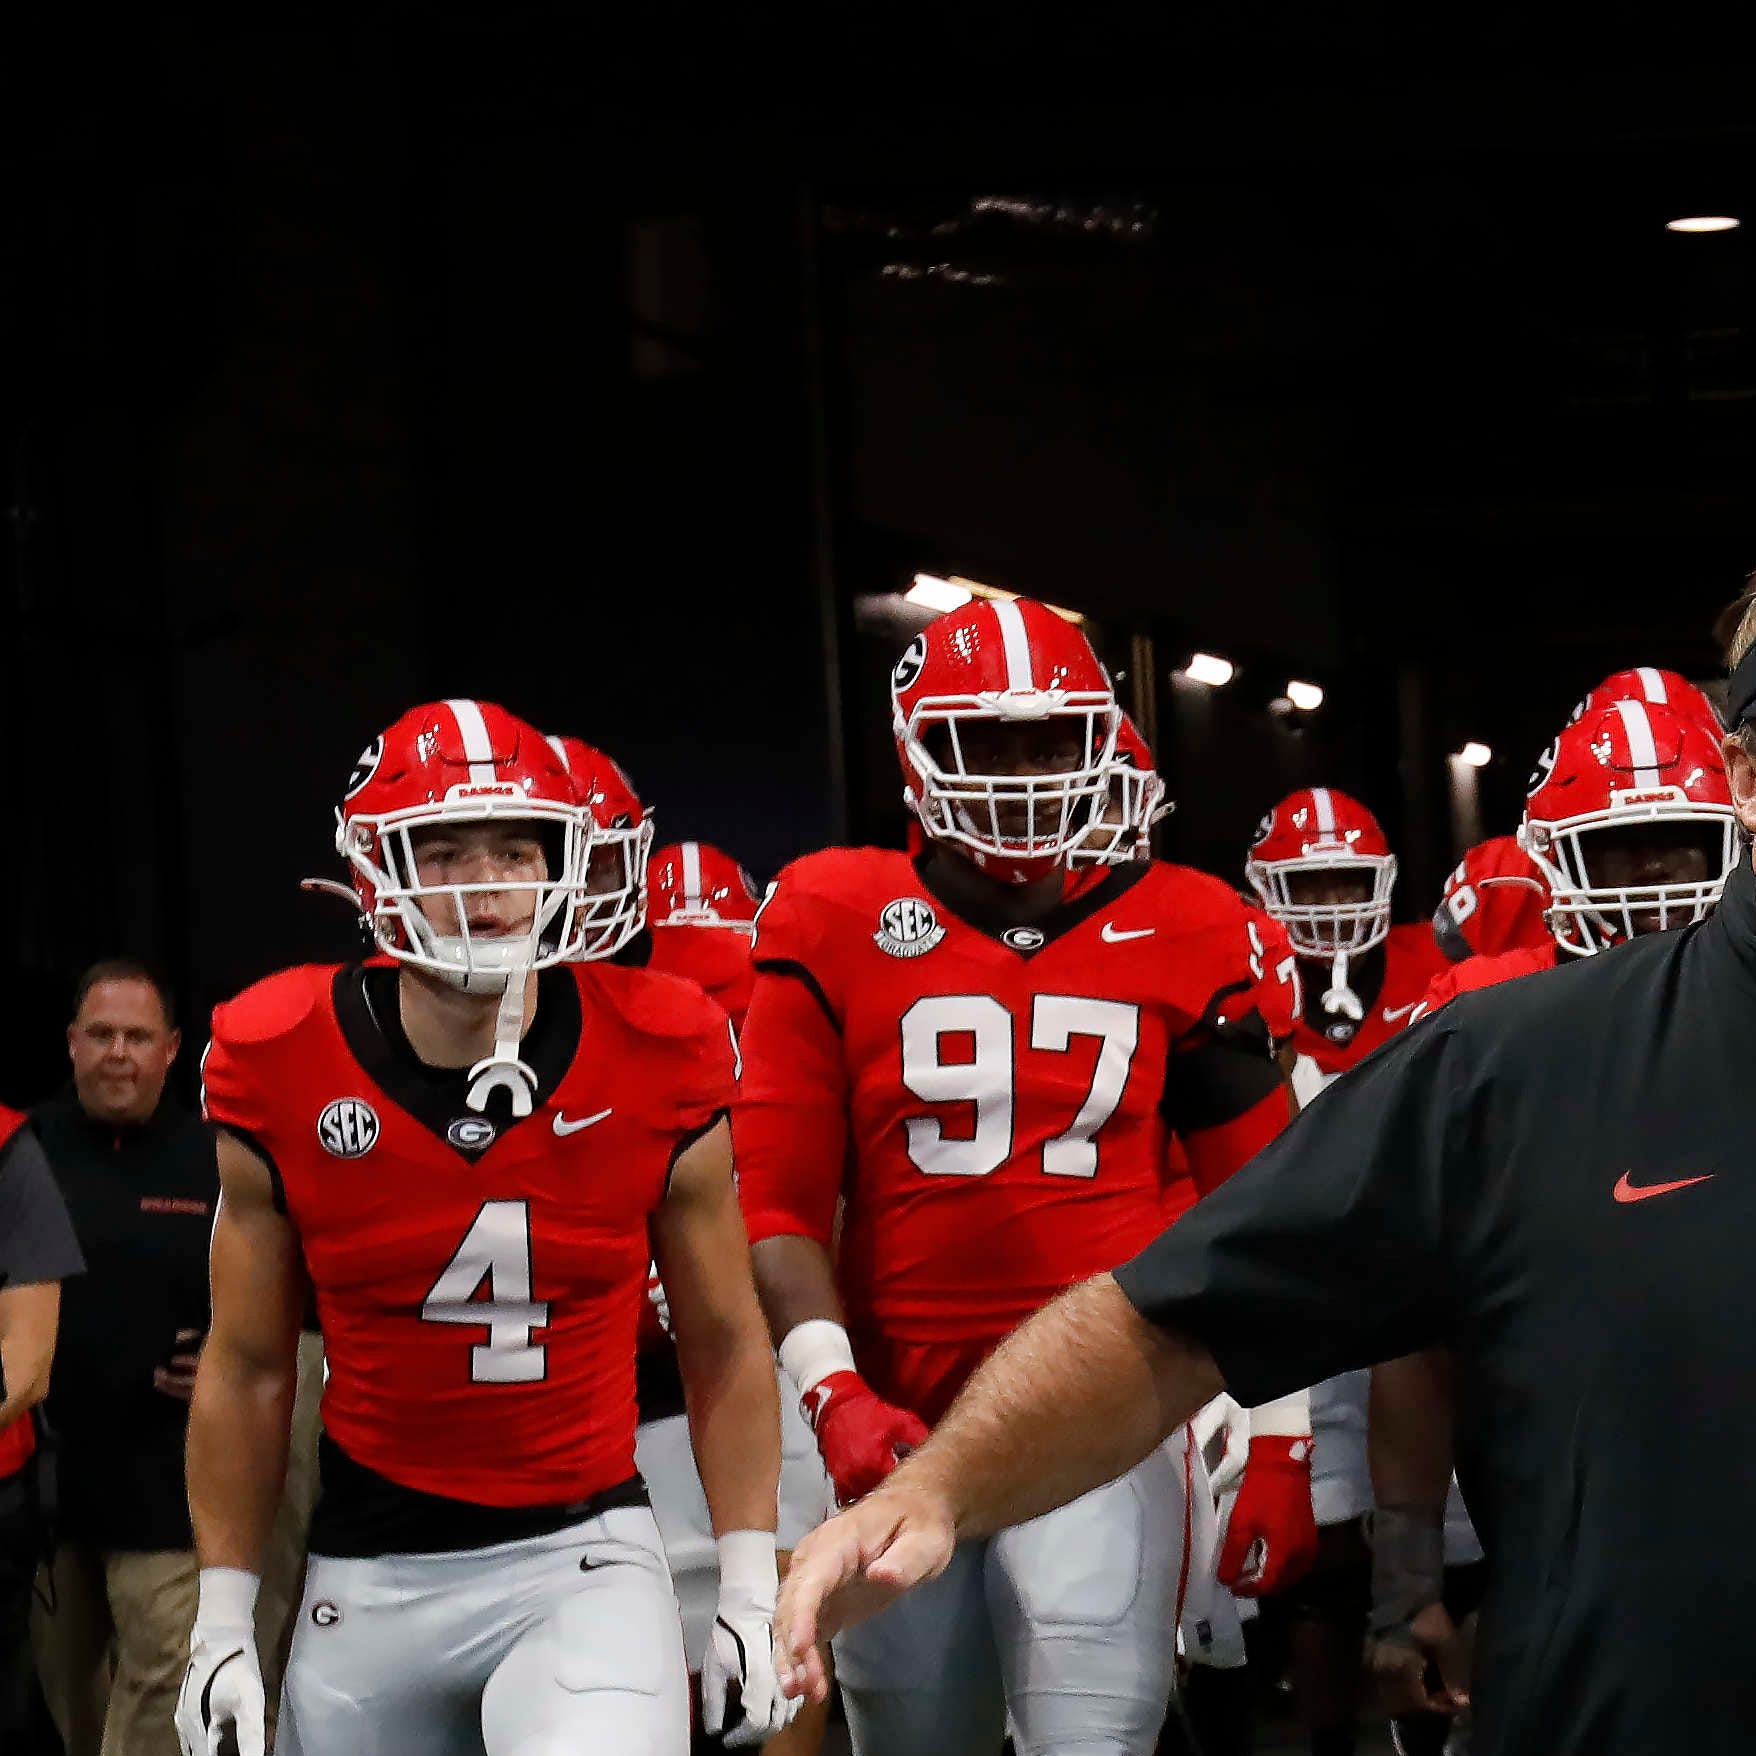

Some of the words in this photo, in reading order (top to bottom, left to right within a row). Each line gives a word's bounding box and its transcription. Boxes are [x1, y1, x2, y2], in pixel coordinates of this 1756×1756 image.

[883, 900, 933, 942] SEC
[321, 1101, 375, 1154] SEC
[900, 994, 1140, 1179] 97
[420, 1199, 548, 1384] 4
